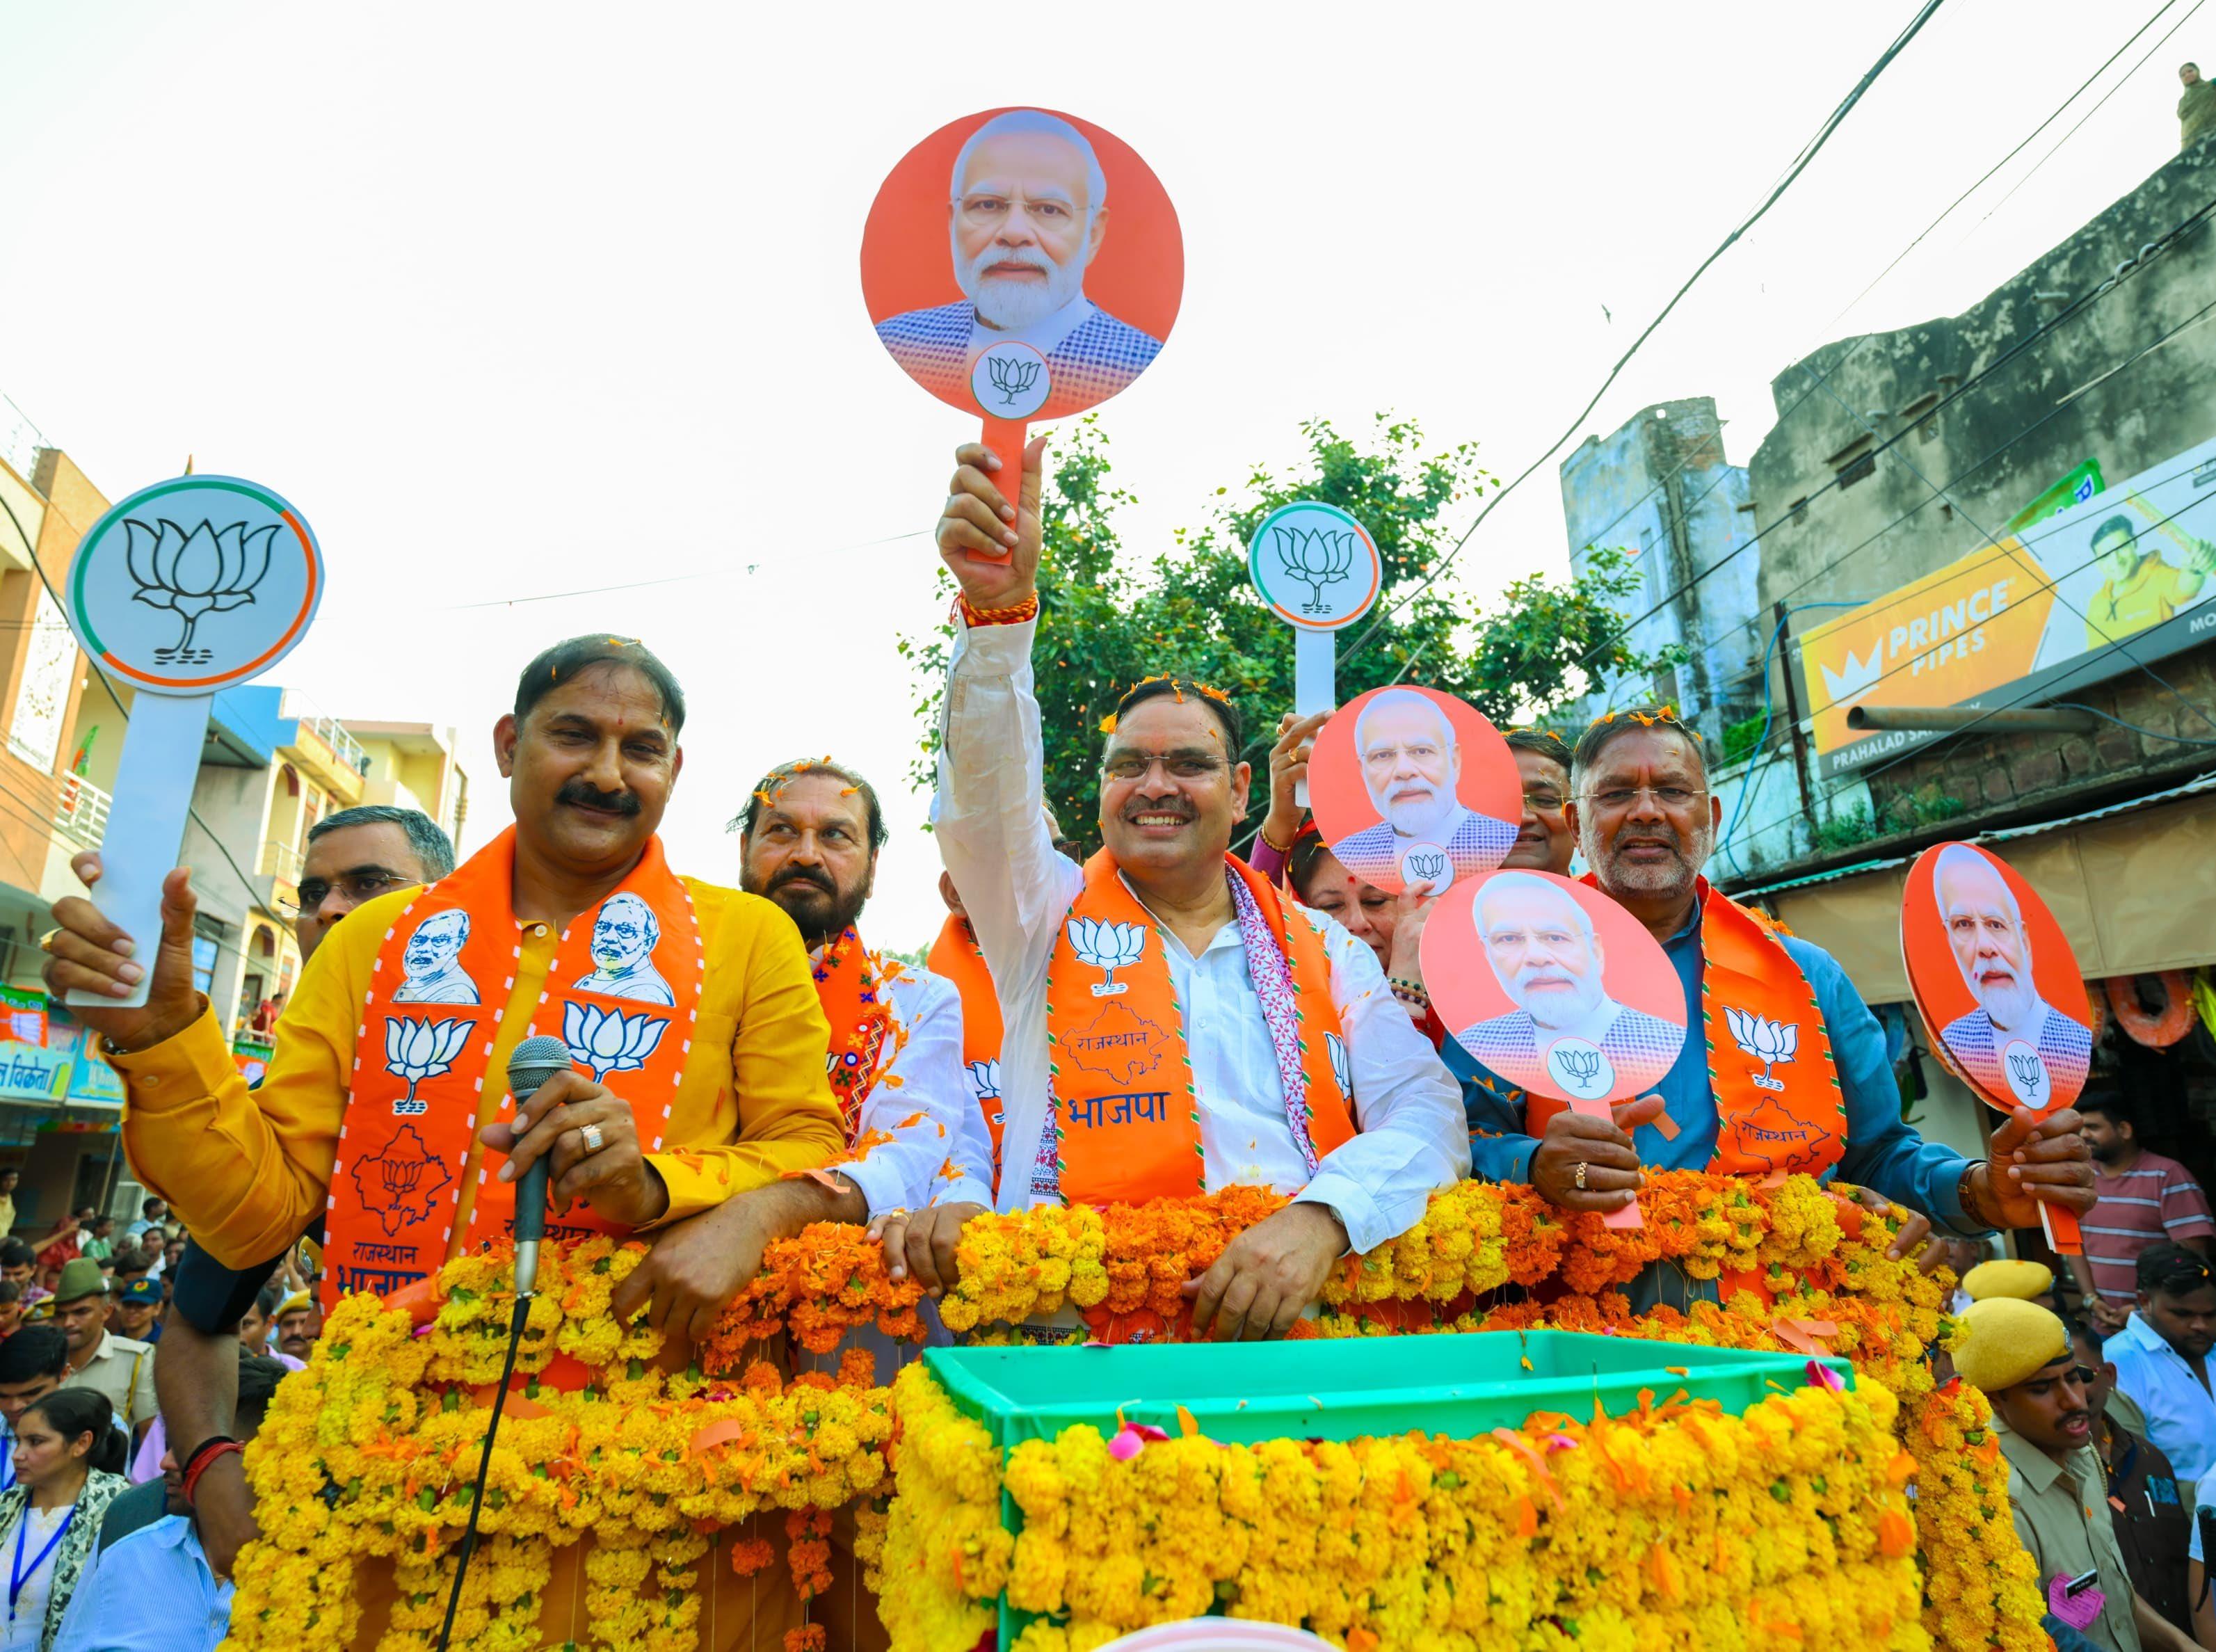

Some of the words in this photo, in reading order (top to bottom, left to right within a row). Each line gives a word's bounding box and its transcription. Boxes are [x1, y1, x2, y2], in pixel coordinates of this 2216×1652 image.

[1890, 579, 2009, 659] PRINCE
[1912, 628, 1985, 677] PIPES
[1832, 731, 1905, 771] PRAHALAD
[1077, 1032, 1148, 1051] राजस्थान
[1068, 1091, 1172, 1129] भाजपा
[1741, 1120, 1806, 1142] राजस्थान
[353, 1242, 419, 1265] राजस्थान
